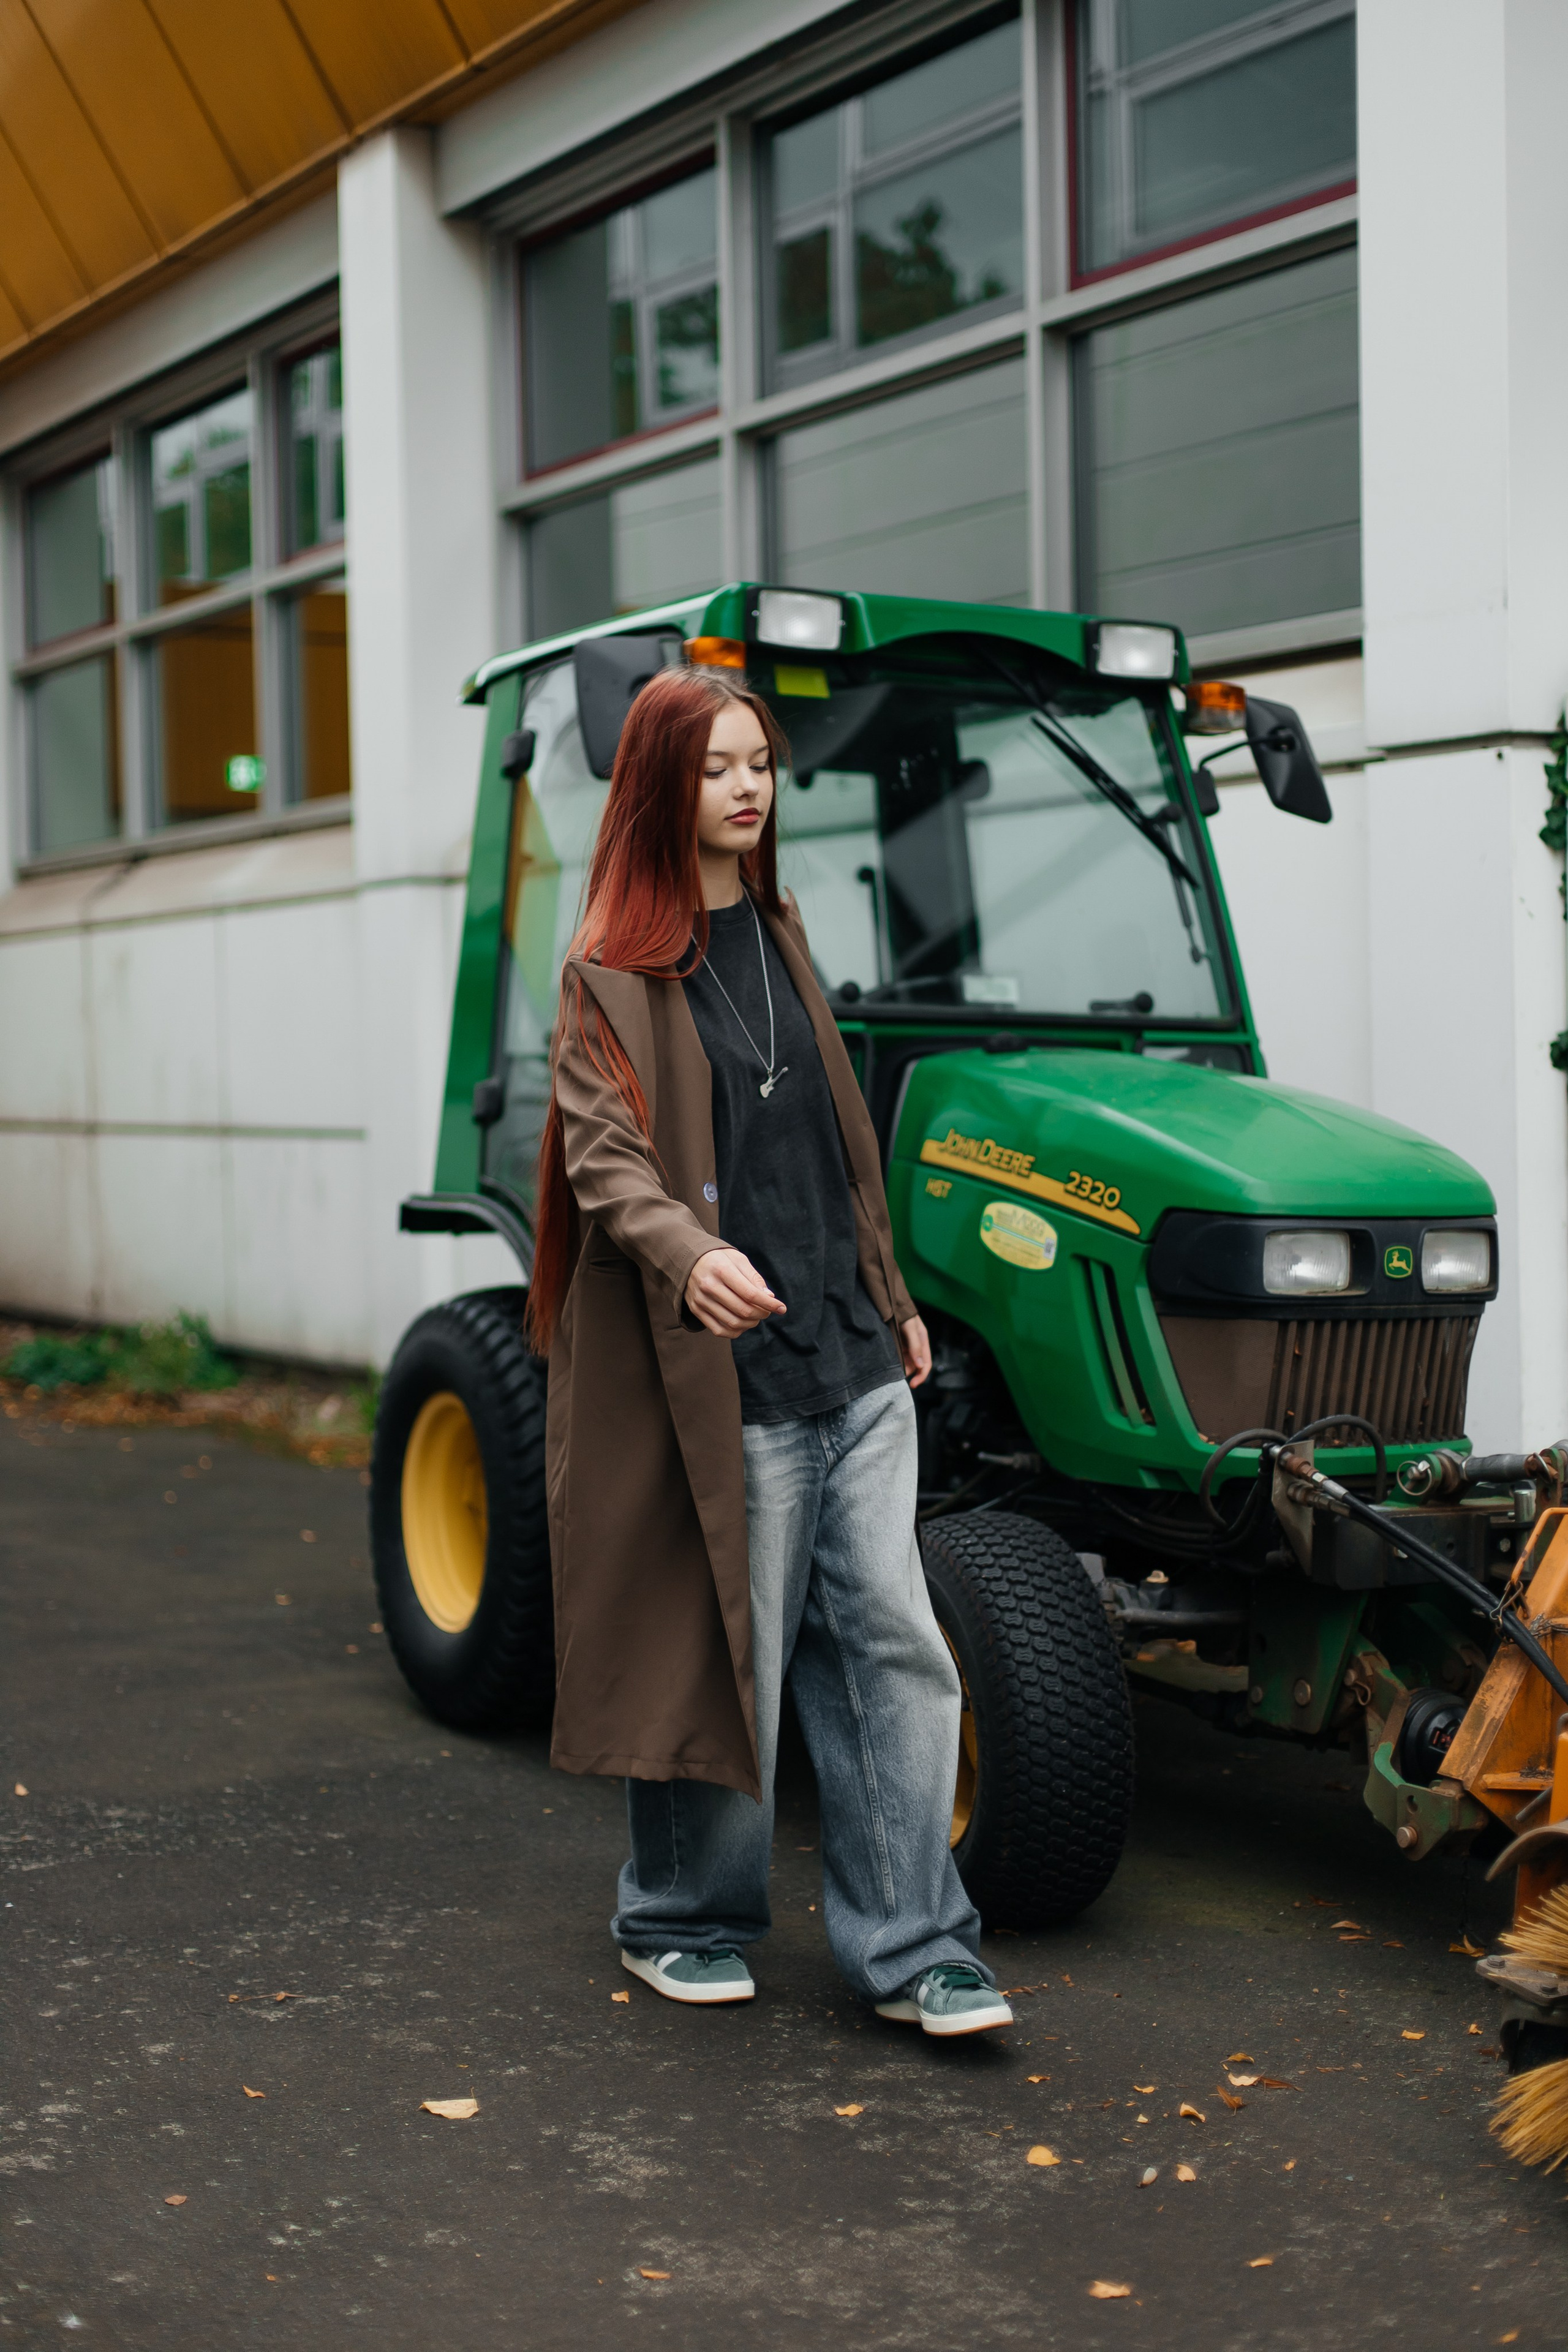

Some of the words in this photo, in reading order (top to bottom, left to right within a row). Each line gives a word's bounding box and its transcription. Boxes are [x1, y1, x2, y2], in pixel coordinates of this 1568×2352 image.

[938, 1128, 980, 1159] JOHN
[978, 1139, 1035, 1176] DEERE
[1065, 1171, 1120, 1208] 2320
